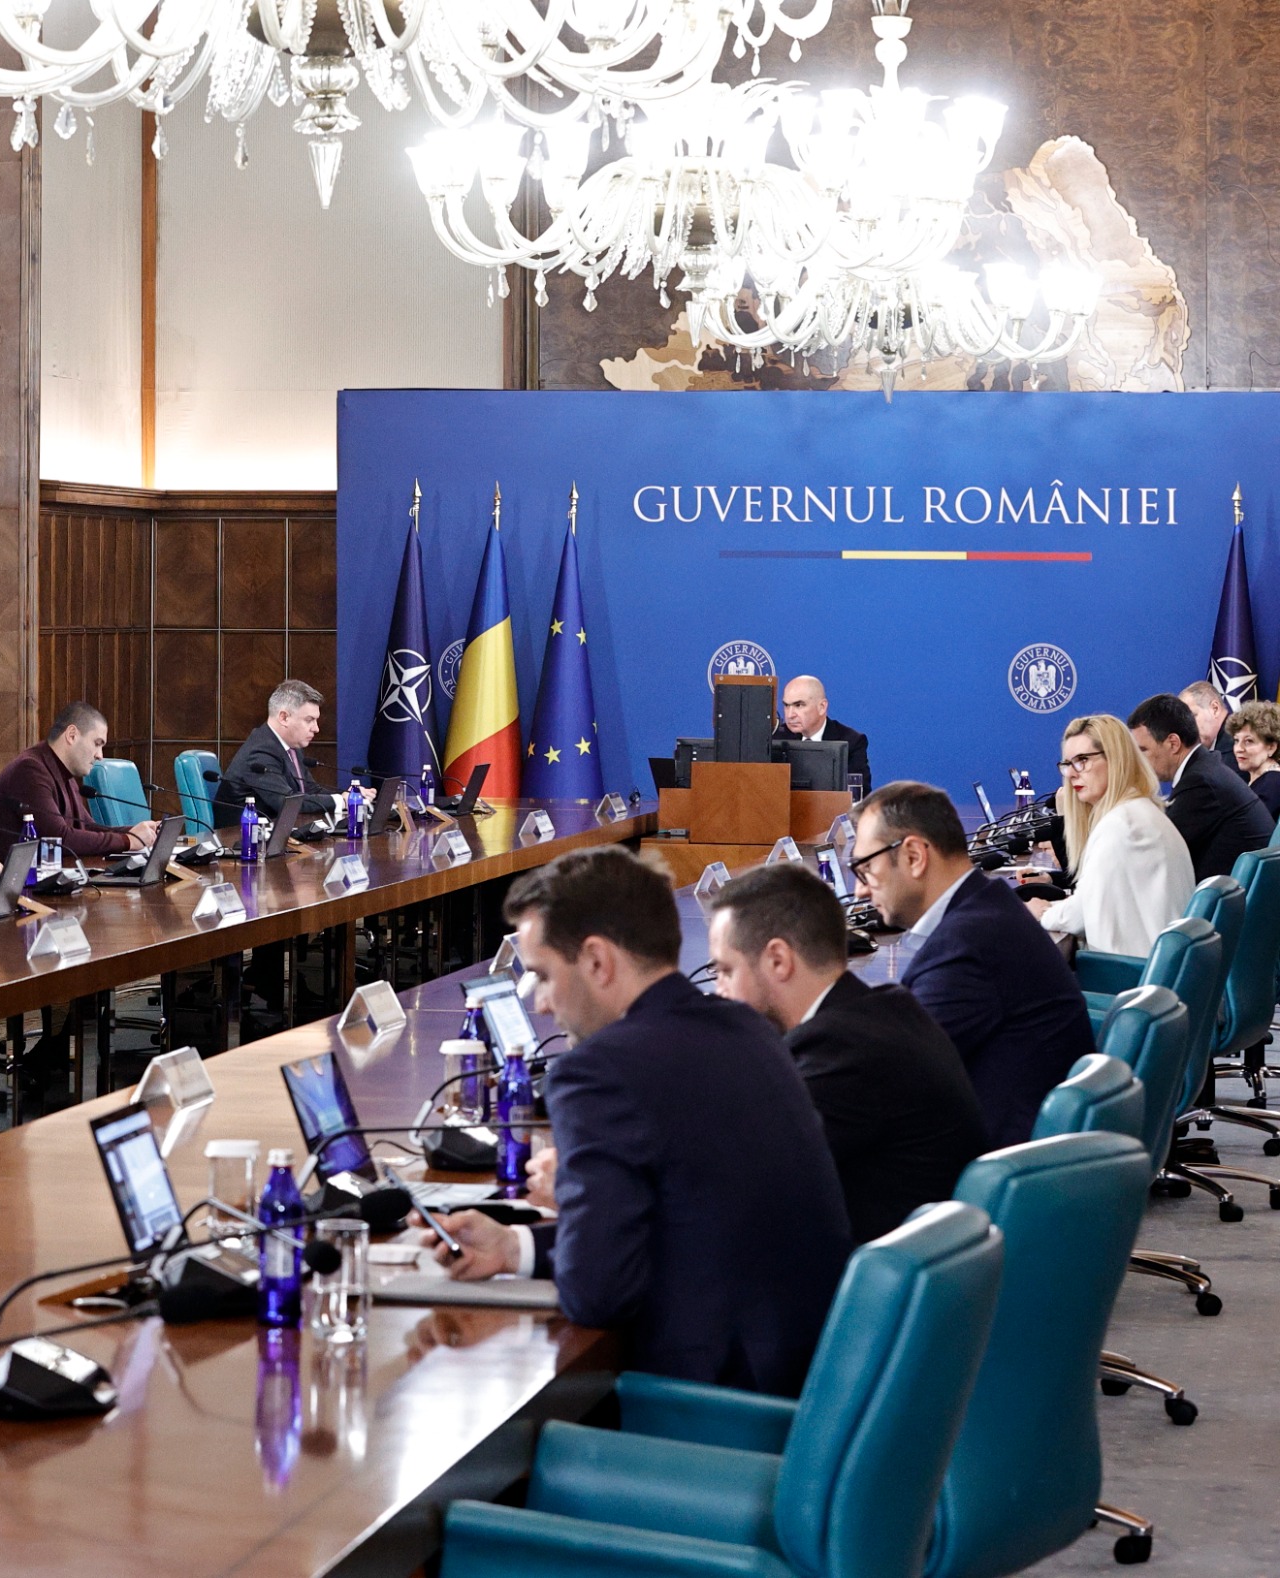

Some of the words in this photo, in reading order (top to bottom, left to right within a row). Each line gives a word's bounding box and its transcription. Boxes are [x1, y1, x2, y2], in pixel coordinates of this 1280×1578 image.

[632, 484, 904, 523] GUVERNUL
[922, 478, 1179, 525] ROMÂNIEI
[714, 644, 769, 668] GUVERNUL
[1015, 647, 1070, 671] GUVERNUL
